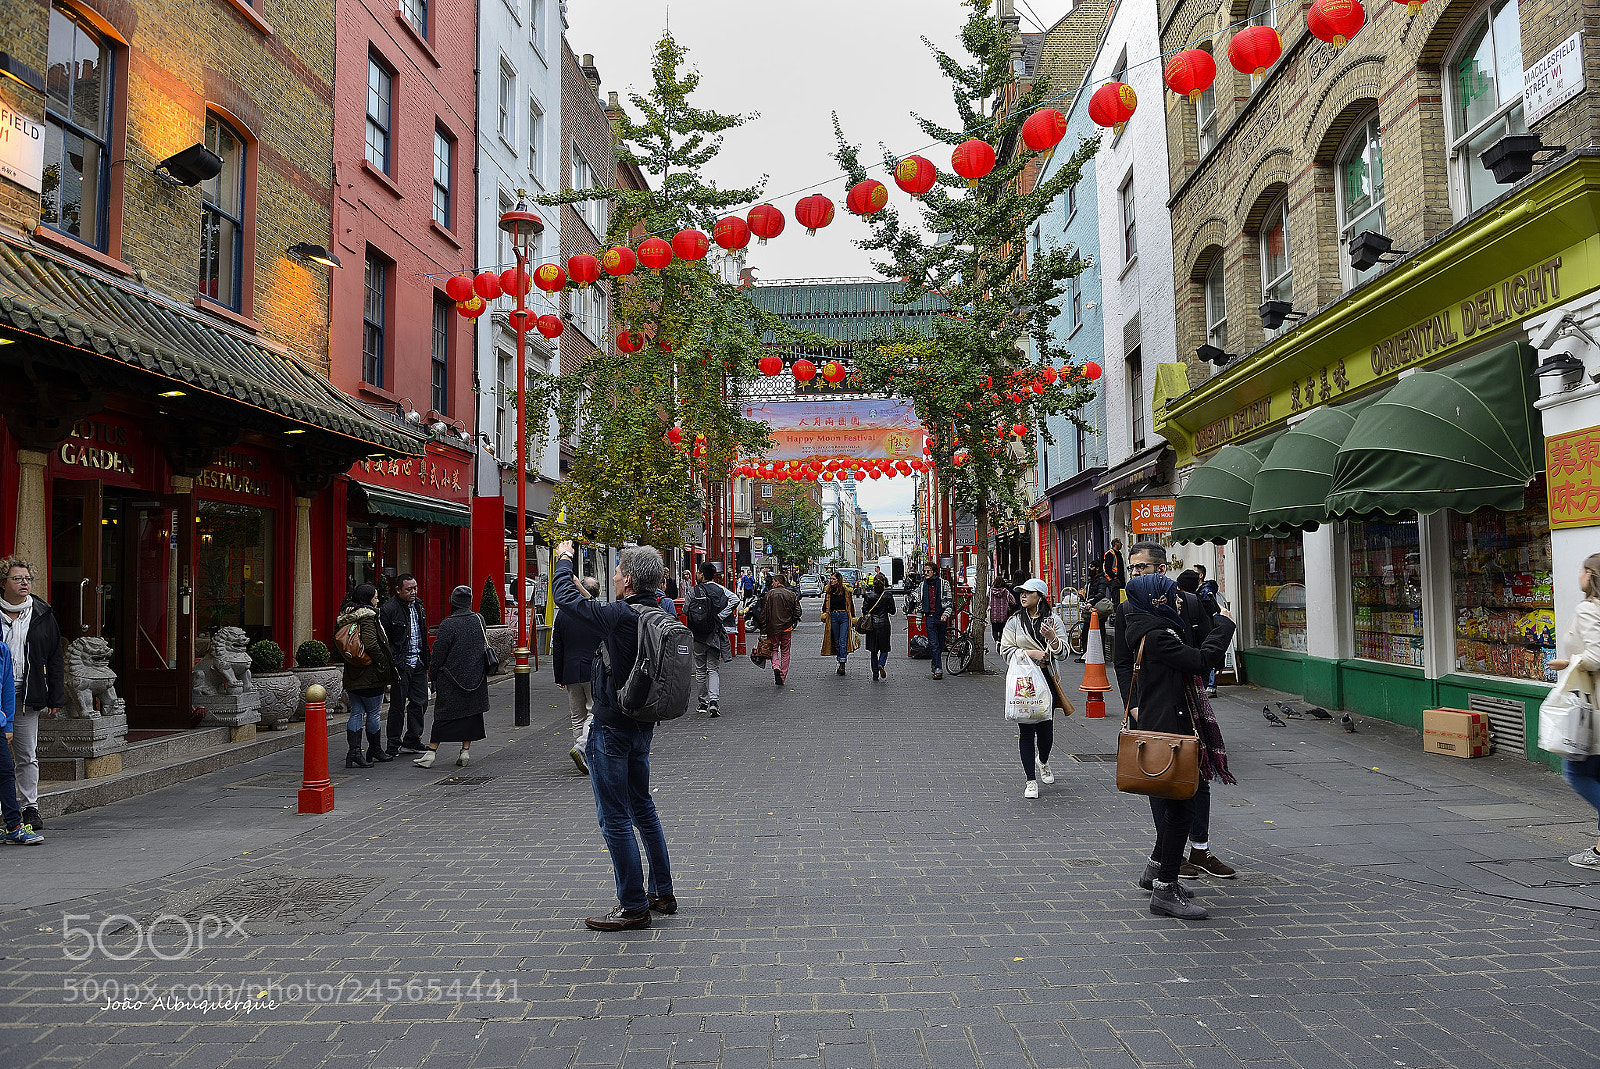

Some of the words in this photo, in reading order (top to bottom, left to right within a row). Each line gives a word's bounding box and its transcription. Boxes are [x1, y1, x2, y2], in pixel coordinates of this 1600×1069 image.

[1524, 38, 1575, 85] MACCLESFIELD
[1525, 72, 1548, 99] STREET
[1550, 63, 1561, 80] W1
[1, 108, 40, 140] FIELD
[1371, 311, 1458, 376] ORIENTAL
[1461, 256, 1562, 337] DELIGHT
[70, 419, 127, 446] LOTUS
[787, 435, 813, 444] Happy
[1195, 416, 1232, 452] ORIENTAL
[1233, 396, 1271, 435] DELIGHT
[61, 443, 134, 474] GARDEN
